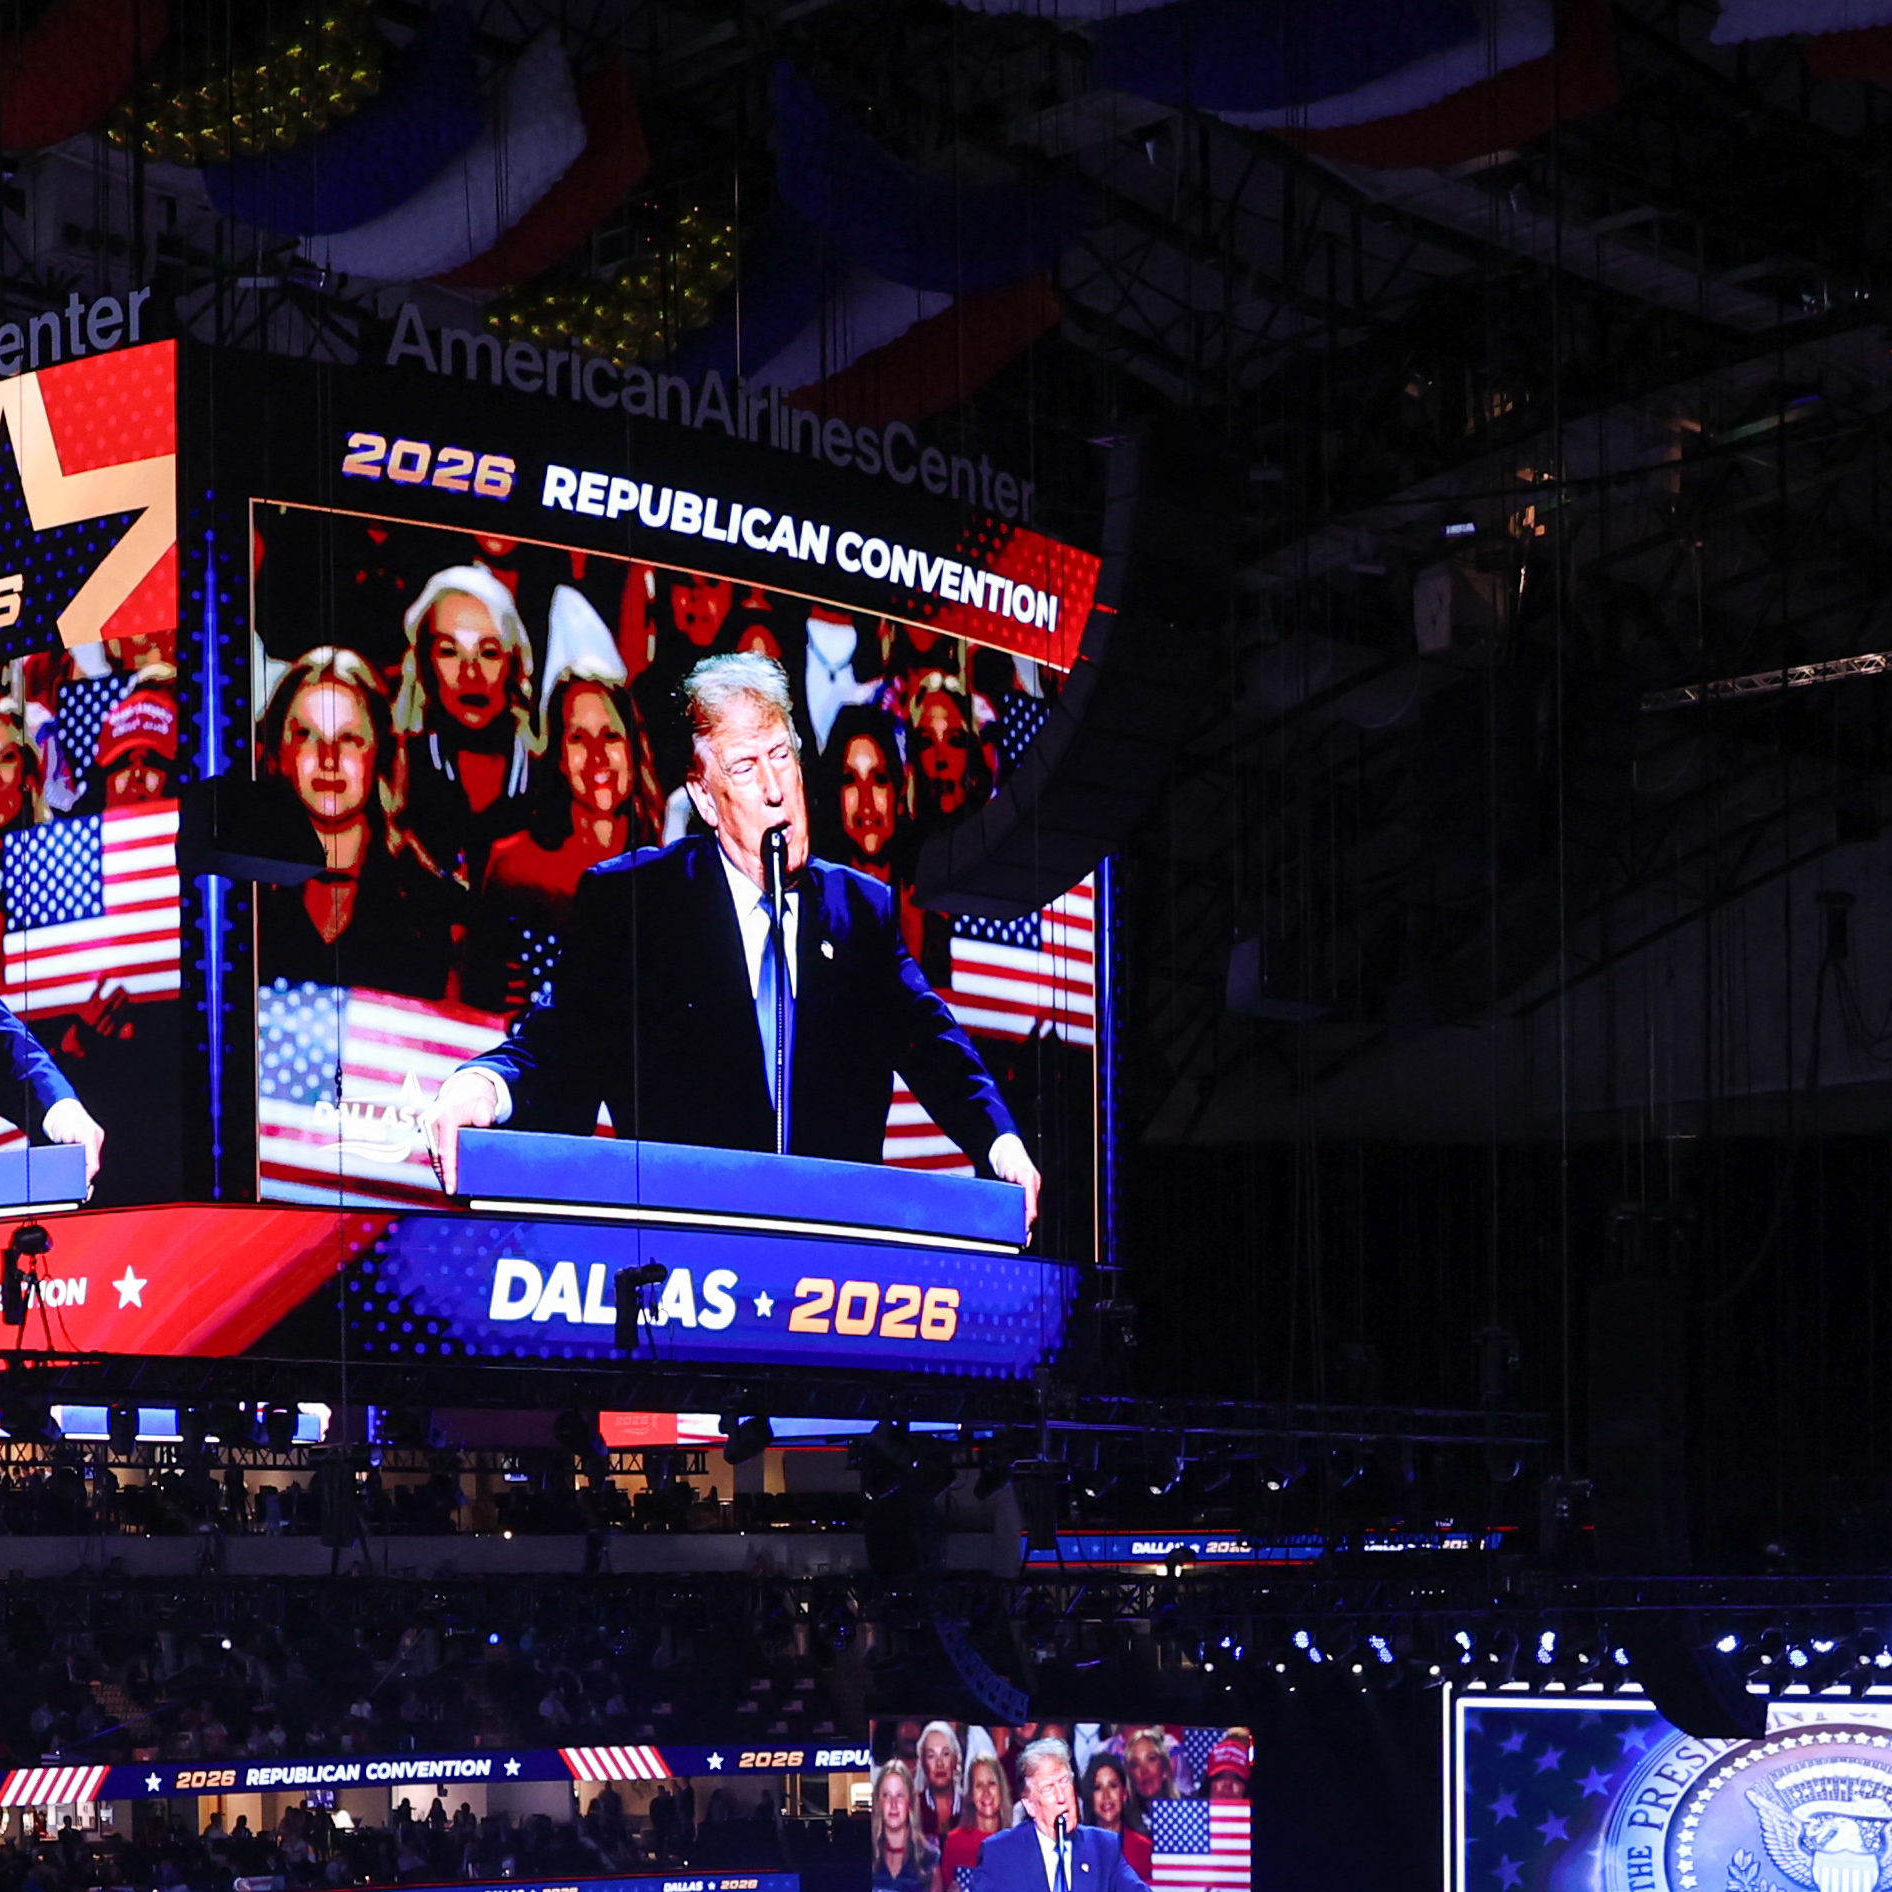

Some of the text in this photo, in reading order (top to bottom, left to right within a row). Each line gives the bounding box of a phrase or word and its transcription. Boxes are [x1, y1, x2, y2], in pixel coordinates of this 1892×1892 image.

[342, 431, 1059, 632] 2026 REPUBLICAN CONVENTION
[788, 1278, 961, 1342] 2026
[175, 1758, 492, 1790] 2026 REPUBLICAN CONVENTION
[738, 1751, 804, 1768] 2026
[720, 1879, 758, 1891] 2026
[1628, 1845, 1654, 1892] THE
